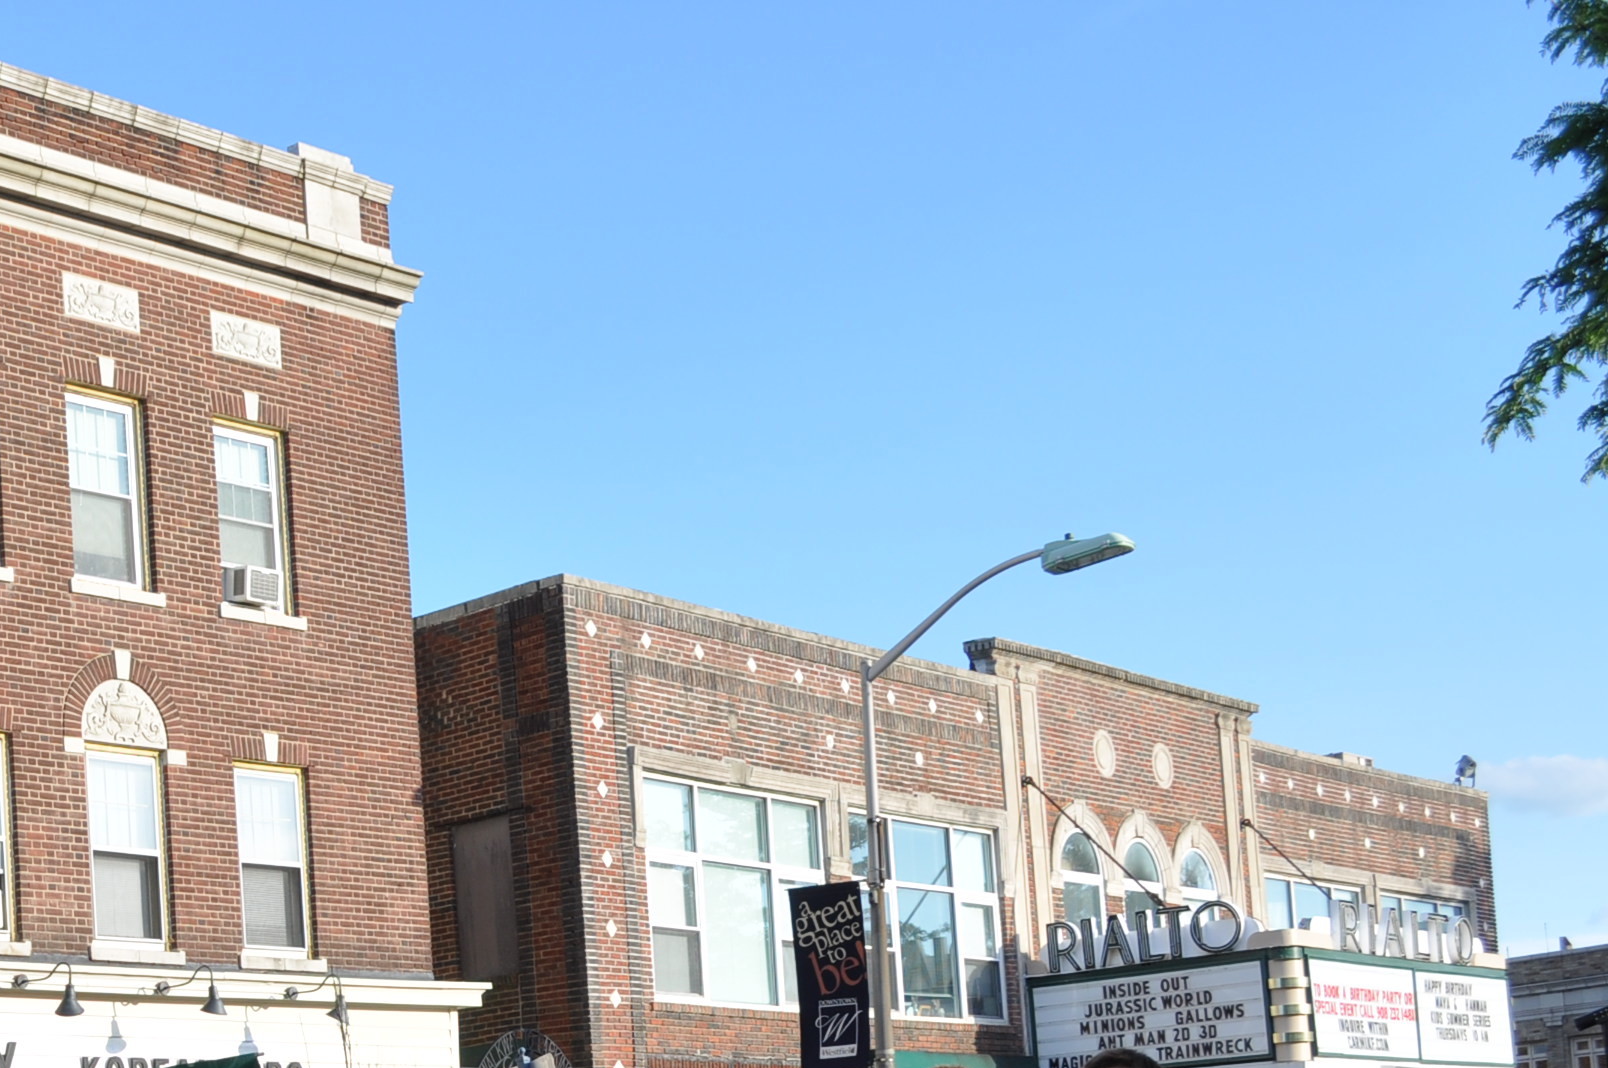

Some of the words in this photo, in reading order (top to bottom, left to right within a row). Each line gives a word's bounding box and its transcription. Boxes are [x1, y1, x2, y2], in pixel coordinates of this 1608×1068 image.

[795, 893, 861, 947] great
[798, 900, 812, 917] a
[812, 920, 862, 959] place
[1046, 900, 1242, 974] RIALTO
[1331, 899, 1474, 966] RIALTO
[808, 940, 868, 995] be!
[826, 946, 847, 964] to
[1103, 981, 1150, 999] INSIDE
[1161, 976, 1189, 992] OUT
[1350, 987, 1380, 1003] BIRTHDAY
[1424, 979, 1442, 993] HAPPY
[1445, 982, 1472, 996] BIRTHDAY
[1084, 997, 1158, 1018] JURASSIC
[1160, 990, 1213, 1010] WORLD
[1080, 1016, 1146, 1035] MINIONS
[1175, 1004, 1245, 1026] GALLOWS
[1098, 1034, 1125, 1050] ANT
[1133, 1029, 1166, 1047] MAN
[1173, 1027, 1190, 1041] 2D
[1199, 1025, 1217, 1039] 3D
[1157, 1038, 1254, 1062] TRAINWRECK
